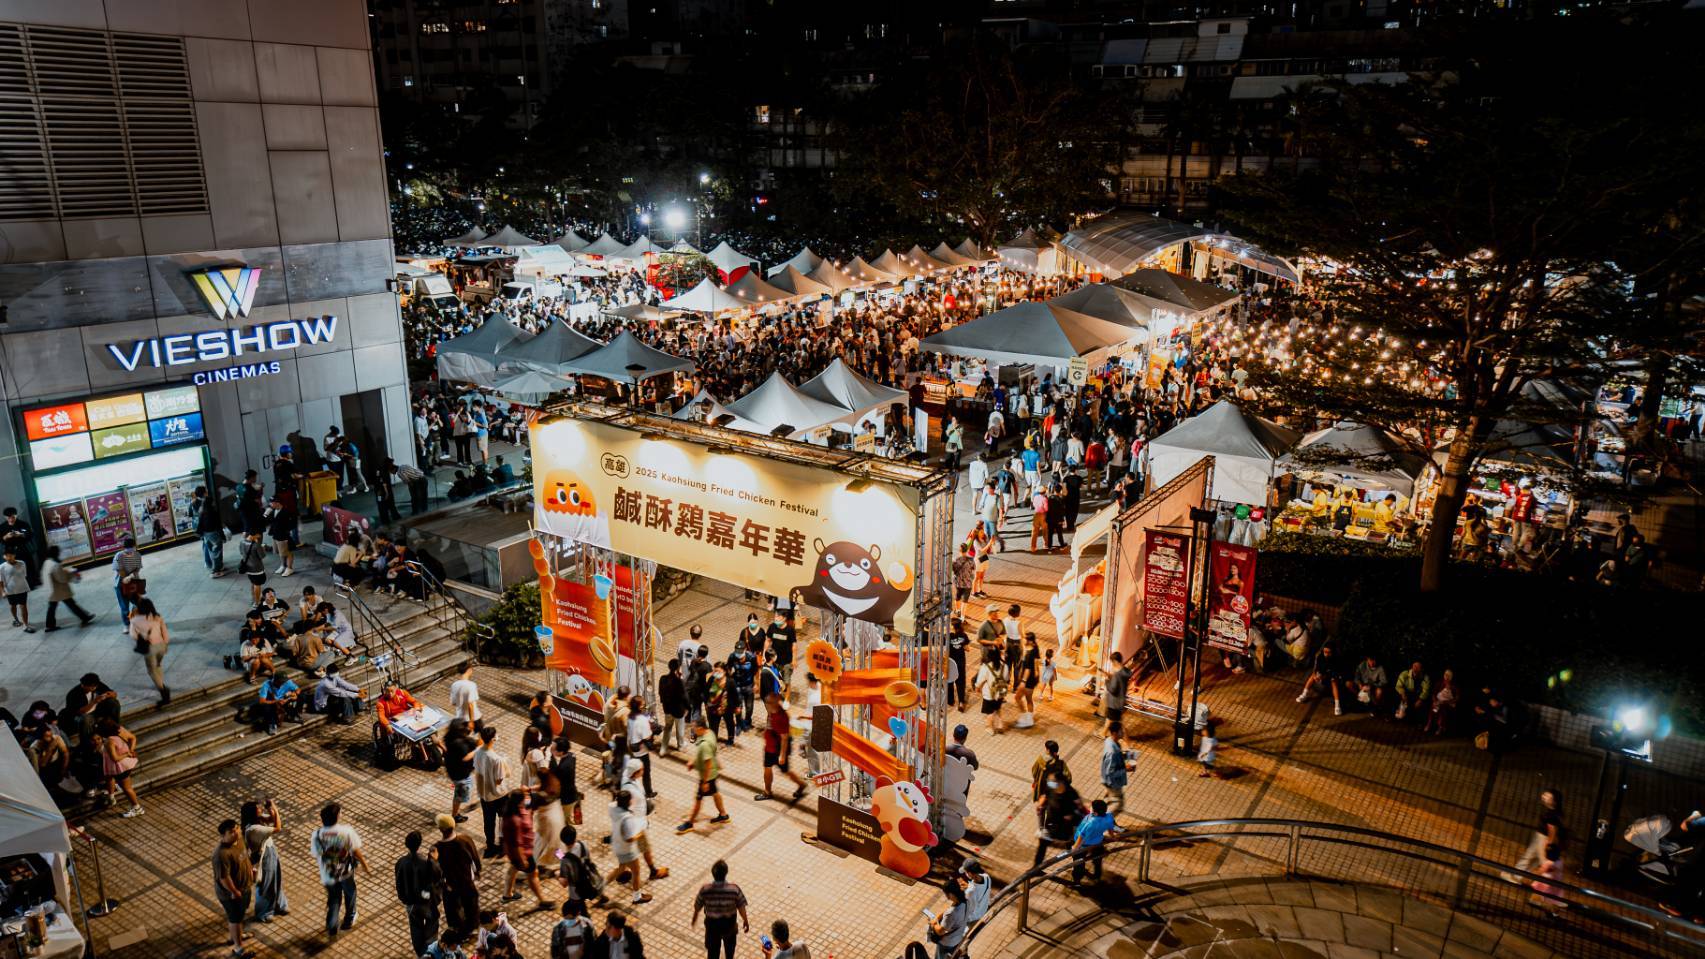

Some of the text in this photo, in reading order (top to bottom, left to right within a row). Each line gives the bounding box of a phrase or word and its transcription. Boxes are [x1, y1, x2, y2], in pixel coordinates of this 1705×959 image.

[107, 315, 338, 372] VIESHOW
[193, 361, 281, 386] CINEMAS
[604, 458, 626, 473] 高雄
[635, 466, 819, 517] 2025 Kaohsiung Fried Chicken Festival
[557, 617, 582, 629] Festival
